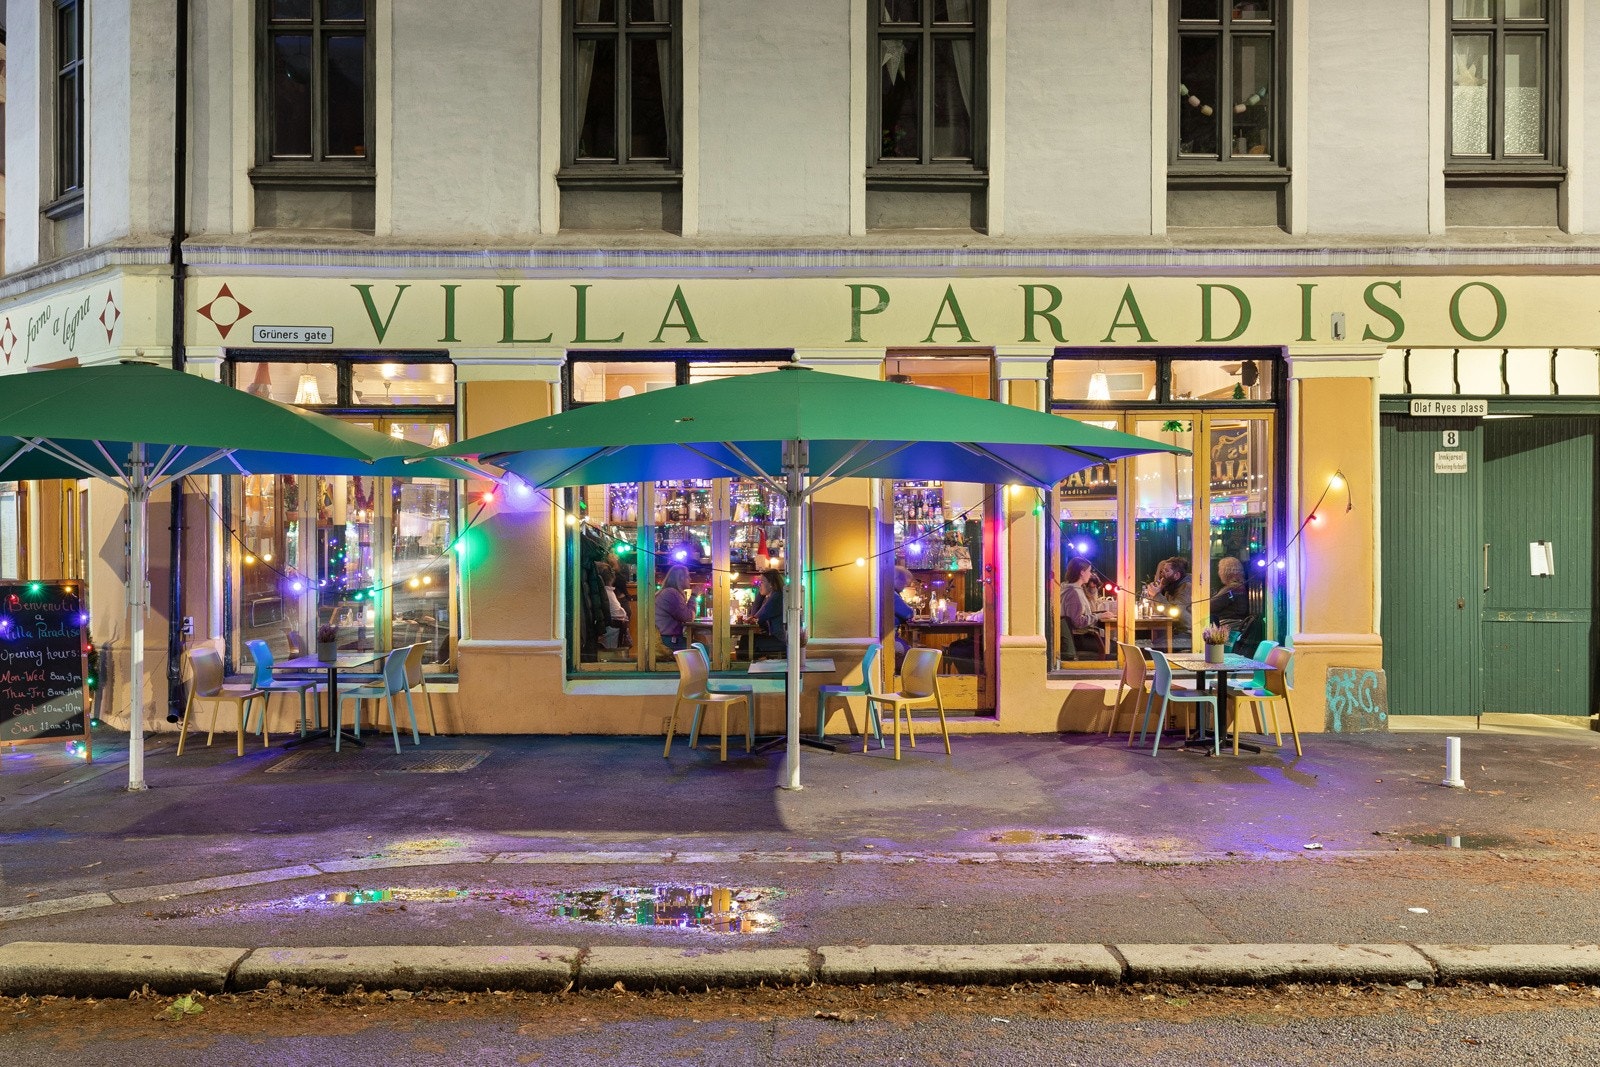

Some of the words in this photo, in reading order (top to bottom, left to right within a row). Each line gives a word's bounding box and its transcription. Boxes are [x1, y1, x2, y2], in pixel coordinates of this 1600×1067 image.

[350, 283, 709, 344] VILLA
[844, 280, 1509, 344] PARADISO
[24, 305, 51, 364] forno
[53, 318, 60, 336] a
[62, 295, 91, 352] legna
[259, 329, 299, 340] Grüners
[304, 331, 327, 341] gate
[1414, 402, 1432, 413] Olaf
[1435, 402, 1457, 415] Ryes
[1461, 402, 1485, 415] plass
[1447, 431, 1456, 445] 8
[5, 594, 76, 613] Benvenuti
[34, 613, 45, 621] a
[4, 625, 33, 640] Villa
[0, 646, 43, 666] Opening
[12, 703, 38, 716] Sat
[11, 722, 38, 735] Sun
